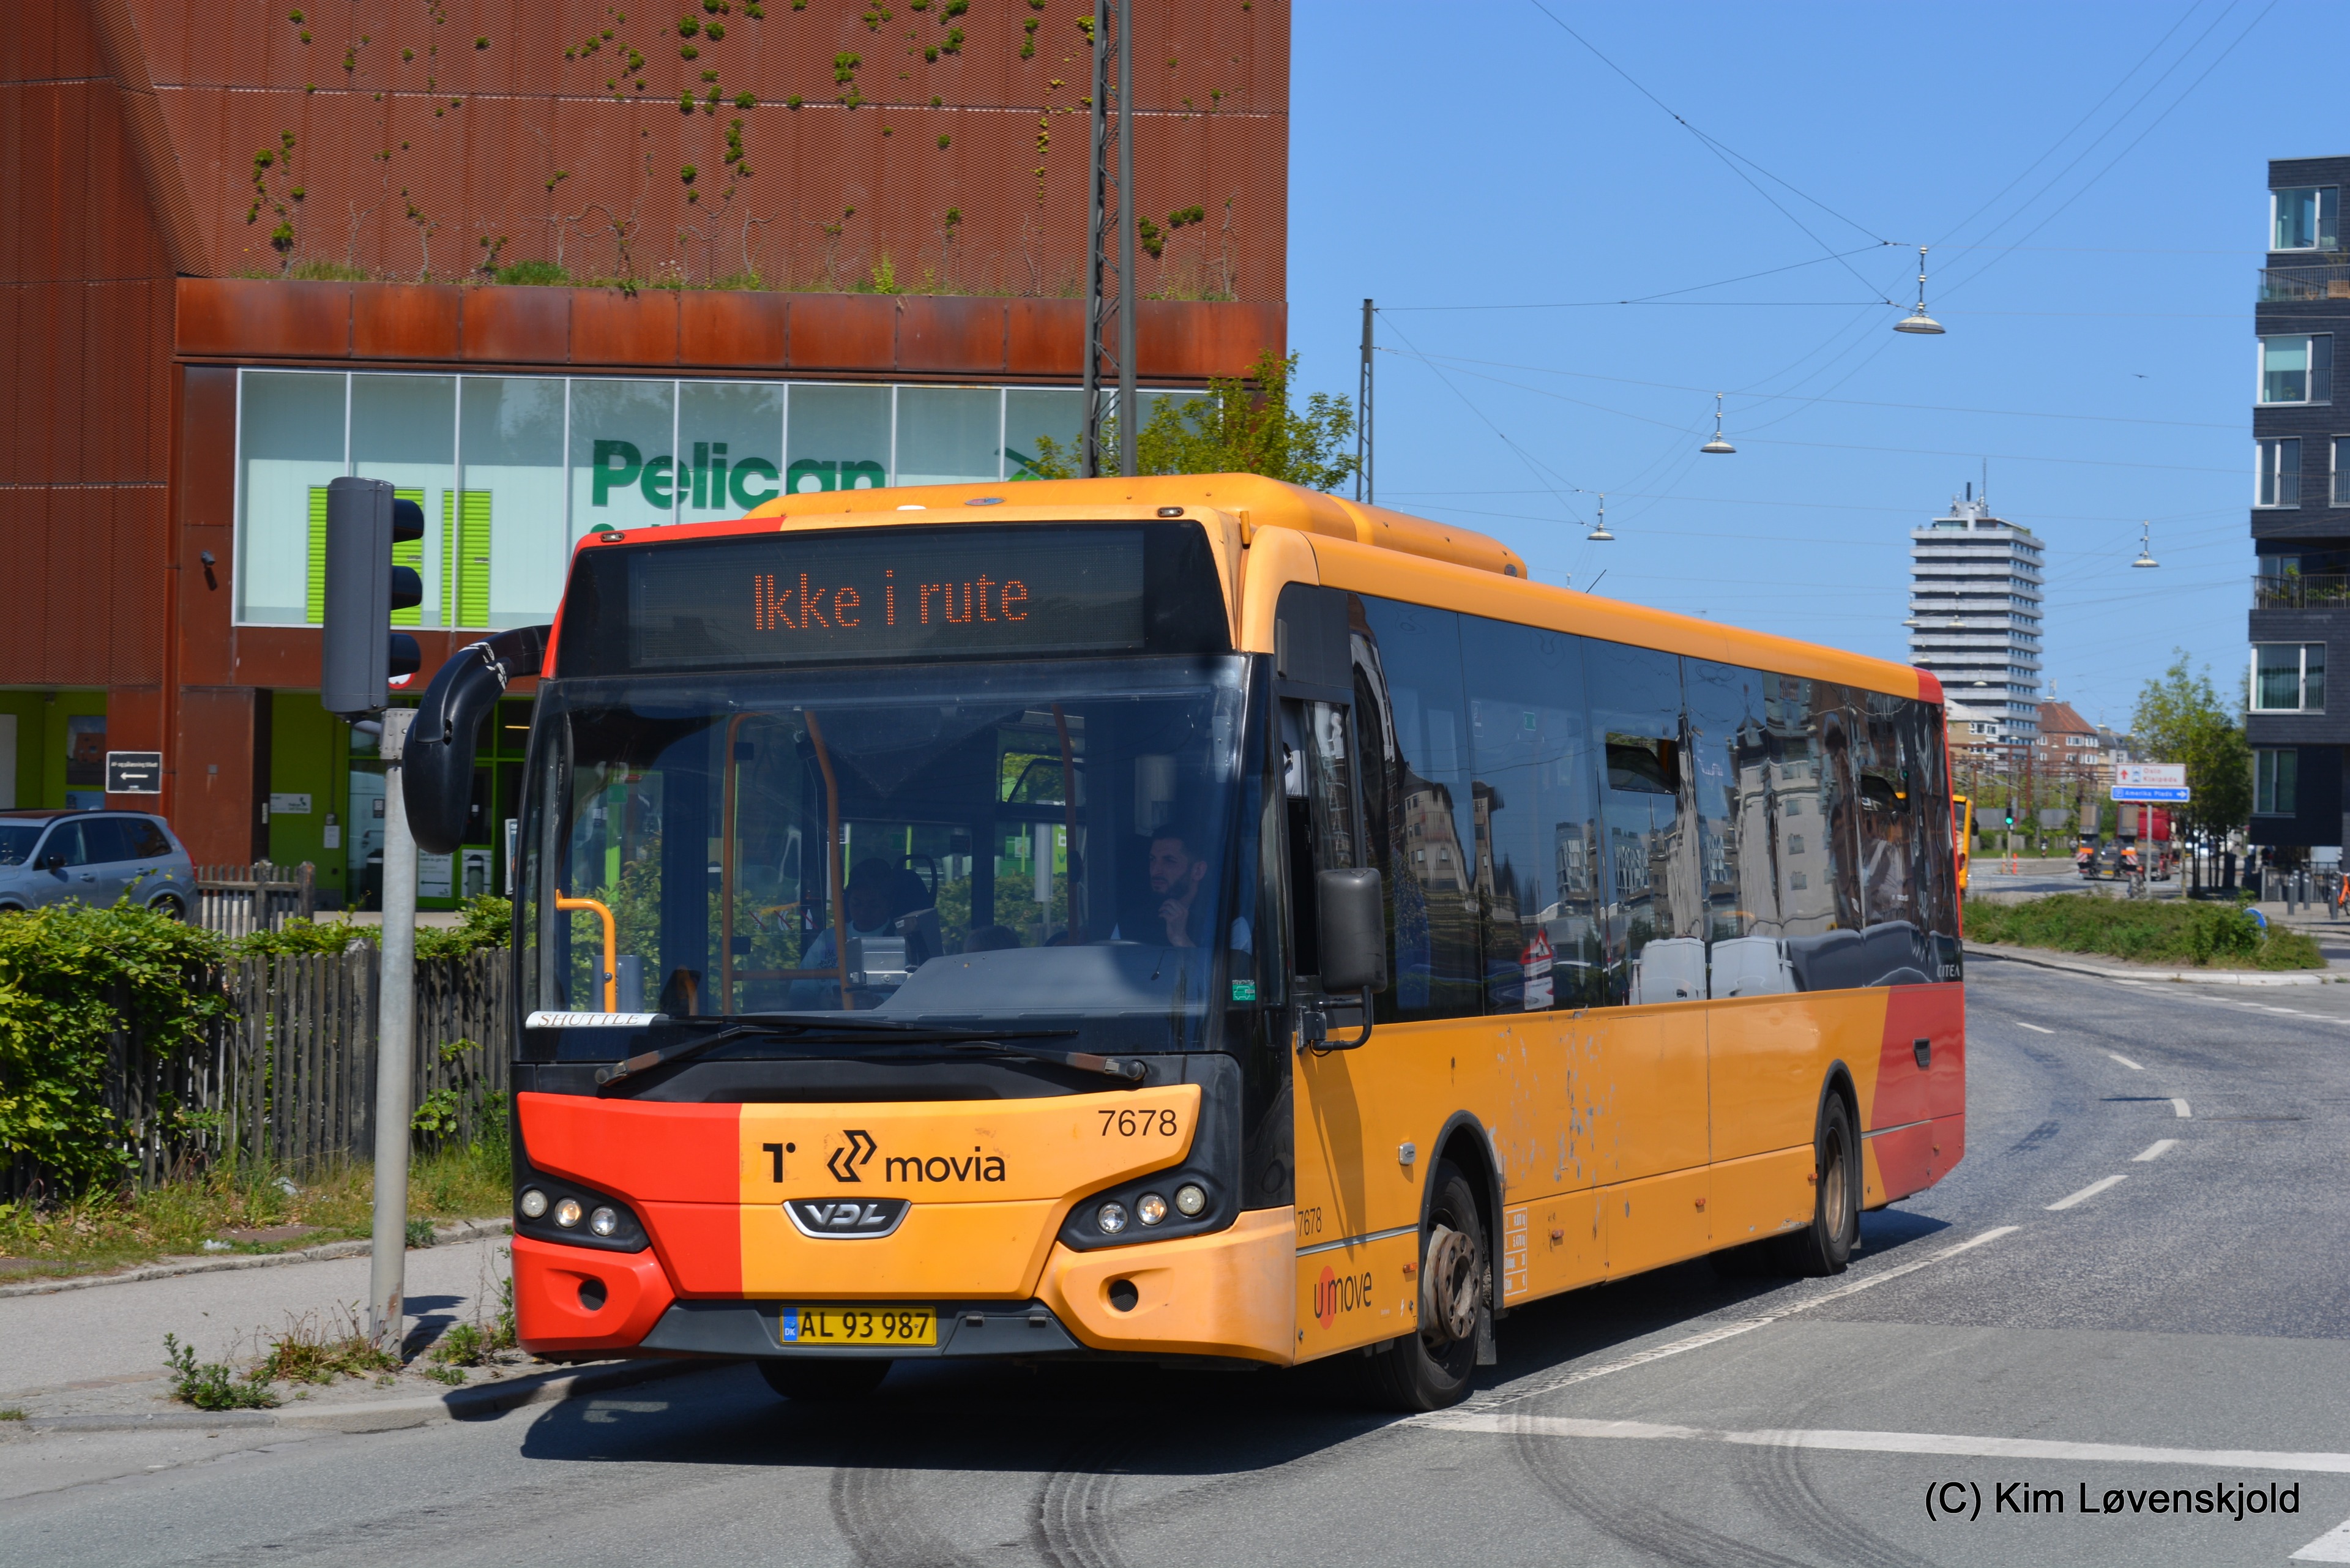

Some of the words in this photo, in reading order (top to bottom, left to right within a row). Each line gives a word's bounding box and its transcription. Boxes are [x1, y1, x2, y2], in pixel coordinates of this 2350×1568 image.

[592, 439, 885, 510] Pelican
[755, 572, 860, 630] Ikke
[886, 570, 894, 625] i
[920, 574, 1028, 623] rute
[538, 1014, 642, 1027] SHUTTLE
[1098, 1109, 1177, 1137] 7678
[886, 1146, 1005, 1182] movia
[804, 1204, 886, 1226] VDL
[1298, 1206, 1322, 1238] 7678
[800, 1312, 834, 1337] AL
[843, 1312, 873, 1338] 93
[882, 1312, 930, 1338] 987
